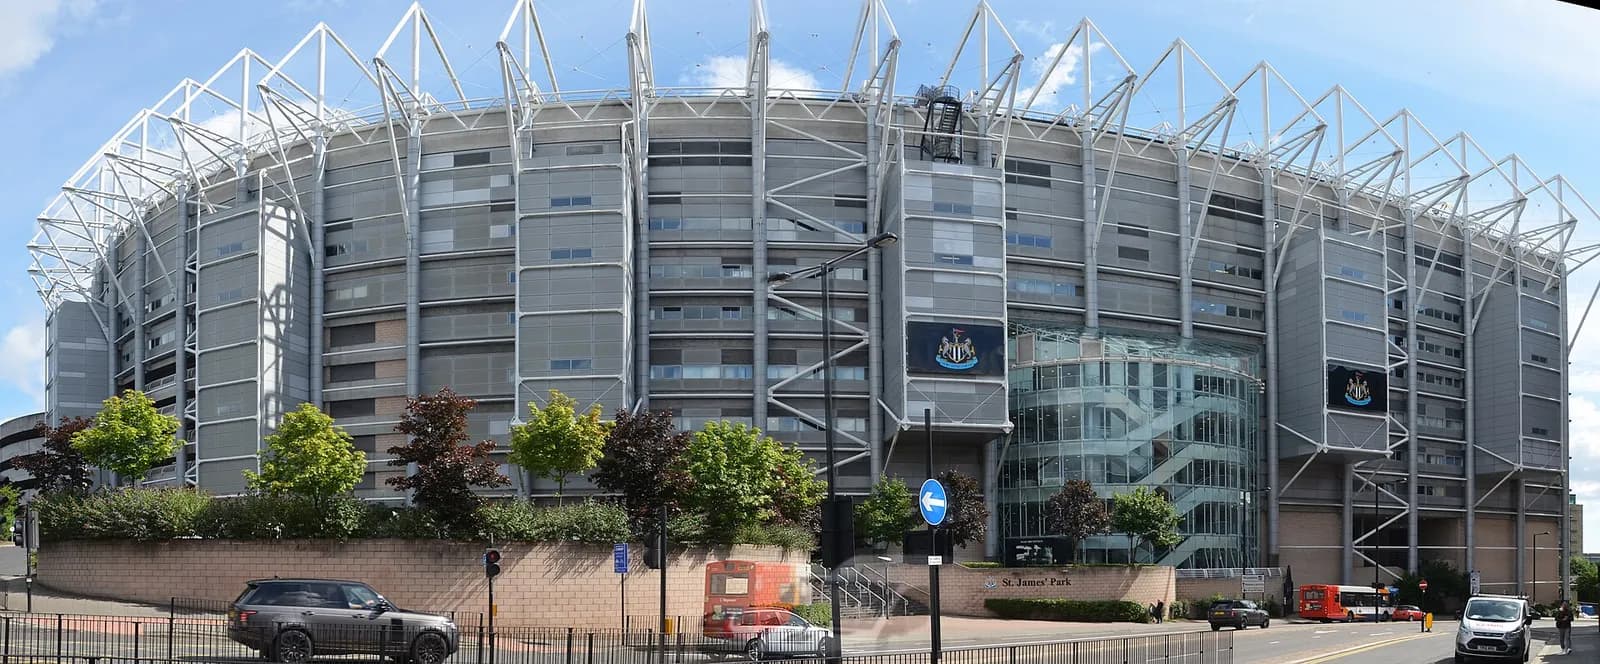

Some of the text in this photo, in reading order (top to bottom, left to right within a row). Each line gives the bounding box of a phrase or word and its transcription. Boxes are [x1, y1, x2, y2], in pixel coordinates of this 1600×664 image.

[1002, 577, 1072, 587] St. James' Park
